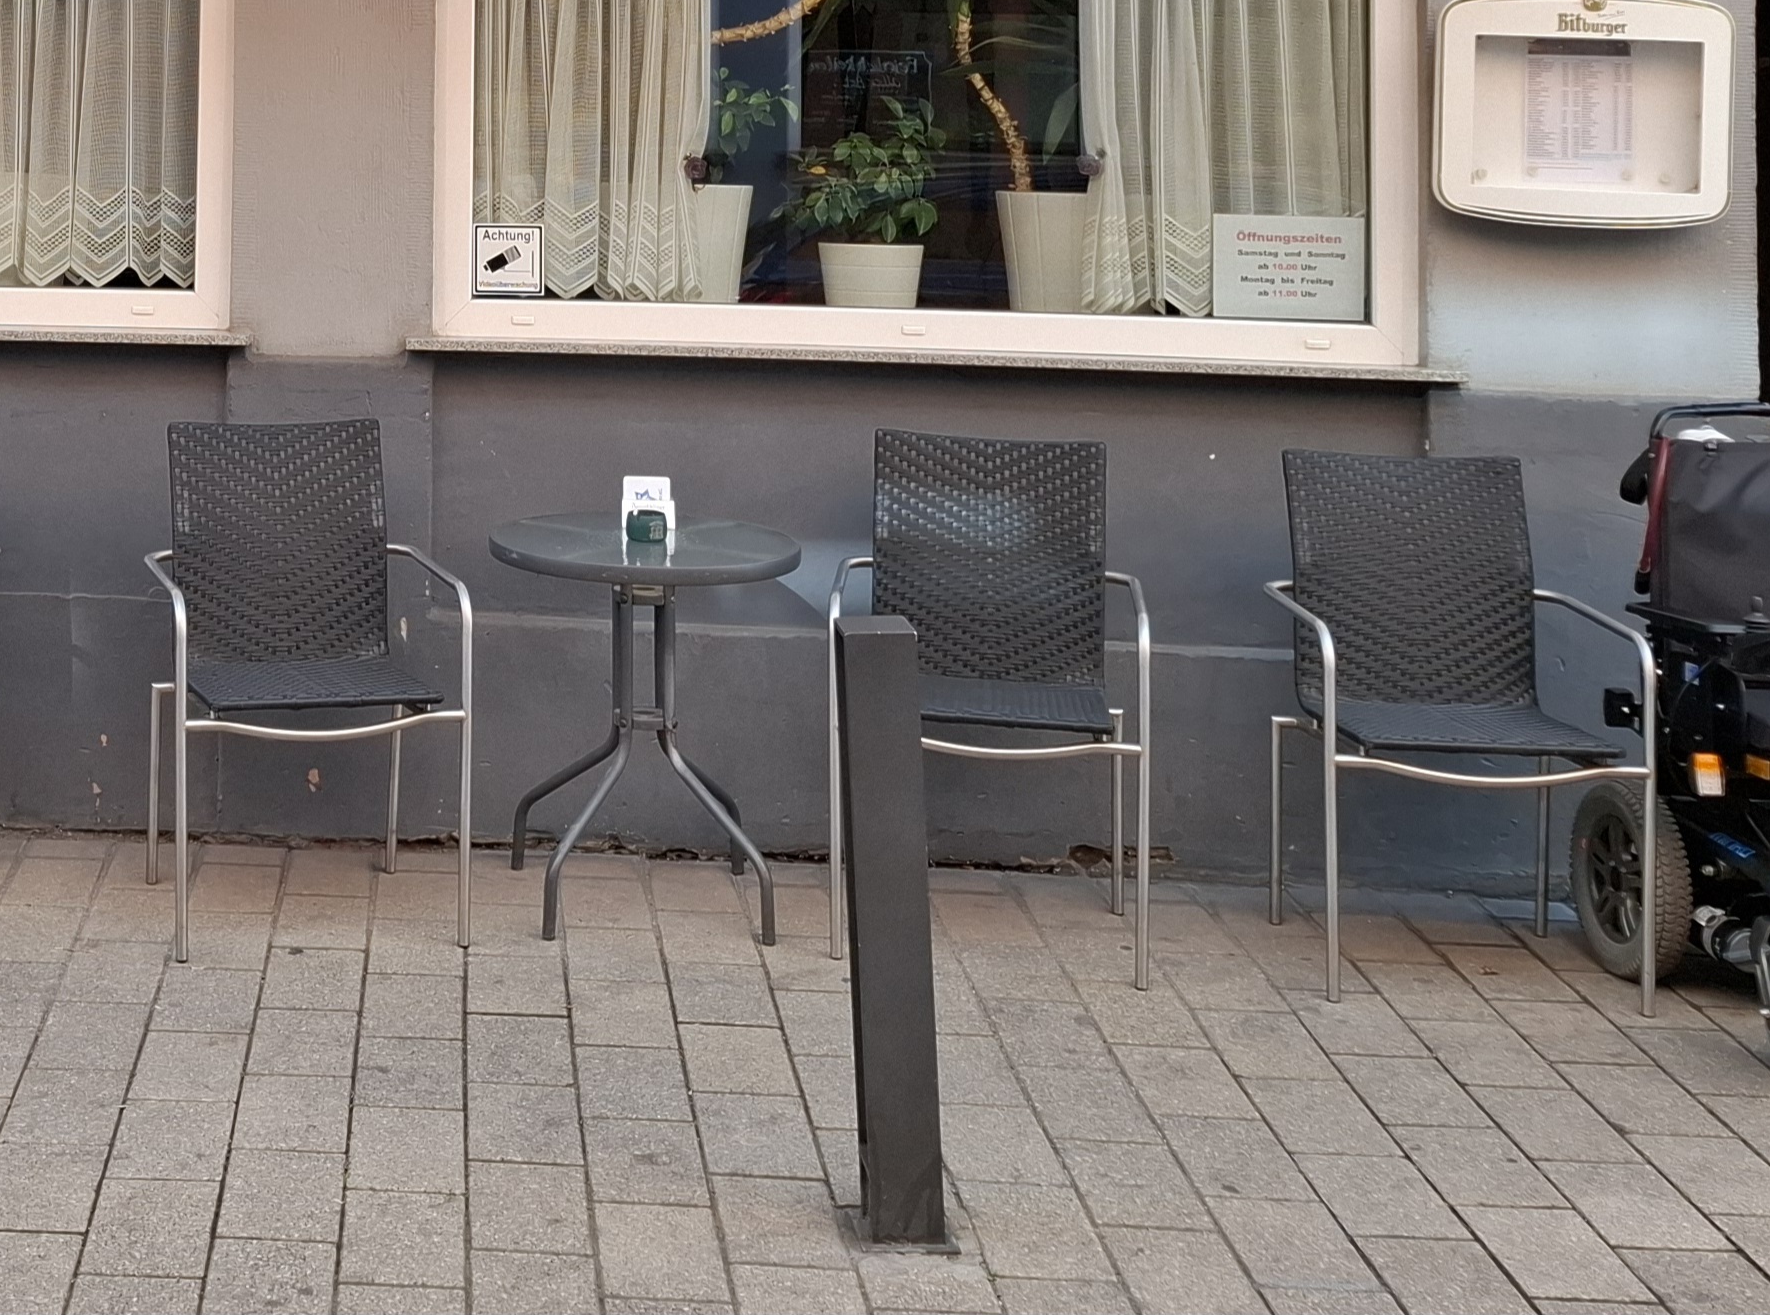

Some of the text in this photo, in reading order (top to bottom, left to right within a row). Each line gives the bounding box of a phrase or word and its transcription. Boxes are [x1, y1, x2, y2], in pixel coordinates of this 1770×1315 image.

[1556, 13, 1628, 37] Bitburger
[482, 229, 535, 244] Achtung!
[1236, 230, 1342, 245] Öffnungszeiten
[1237, 249, 1346, 260] Samstag und Sonntag
[1257, 263, 1269, 271] ab
[1300, 264, 1317, 272] Uhr
[1240, 275, 1334, 286] Montag bis Freitag
[1300, 290, 1317, 298] Uhr
